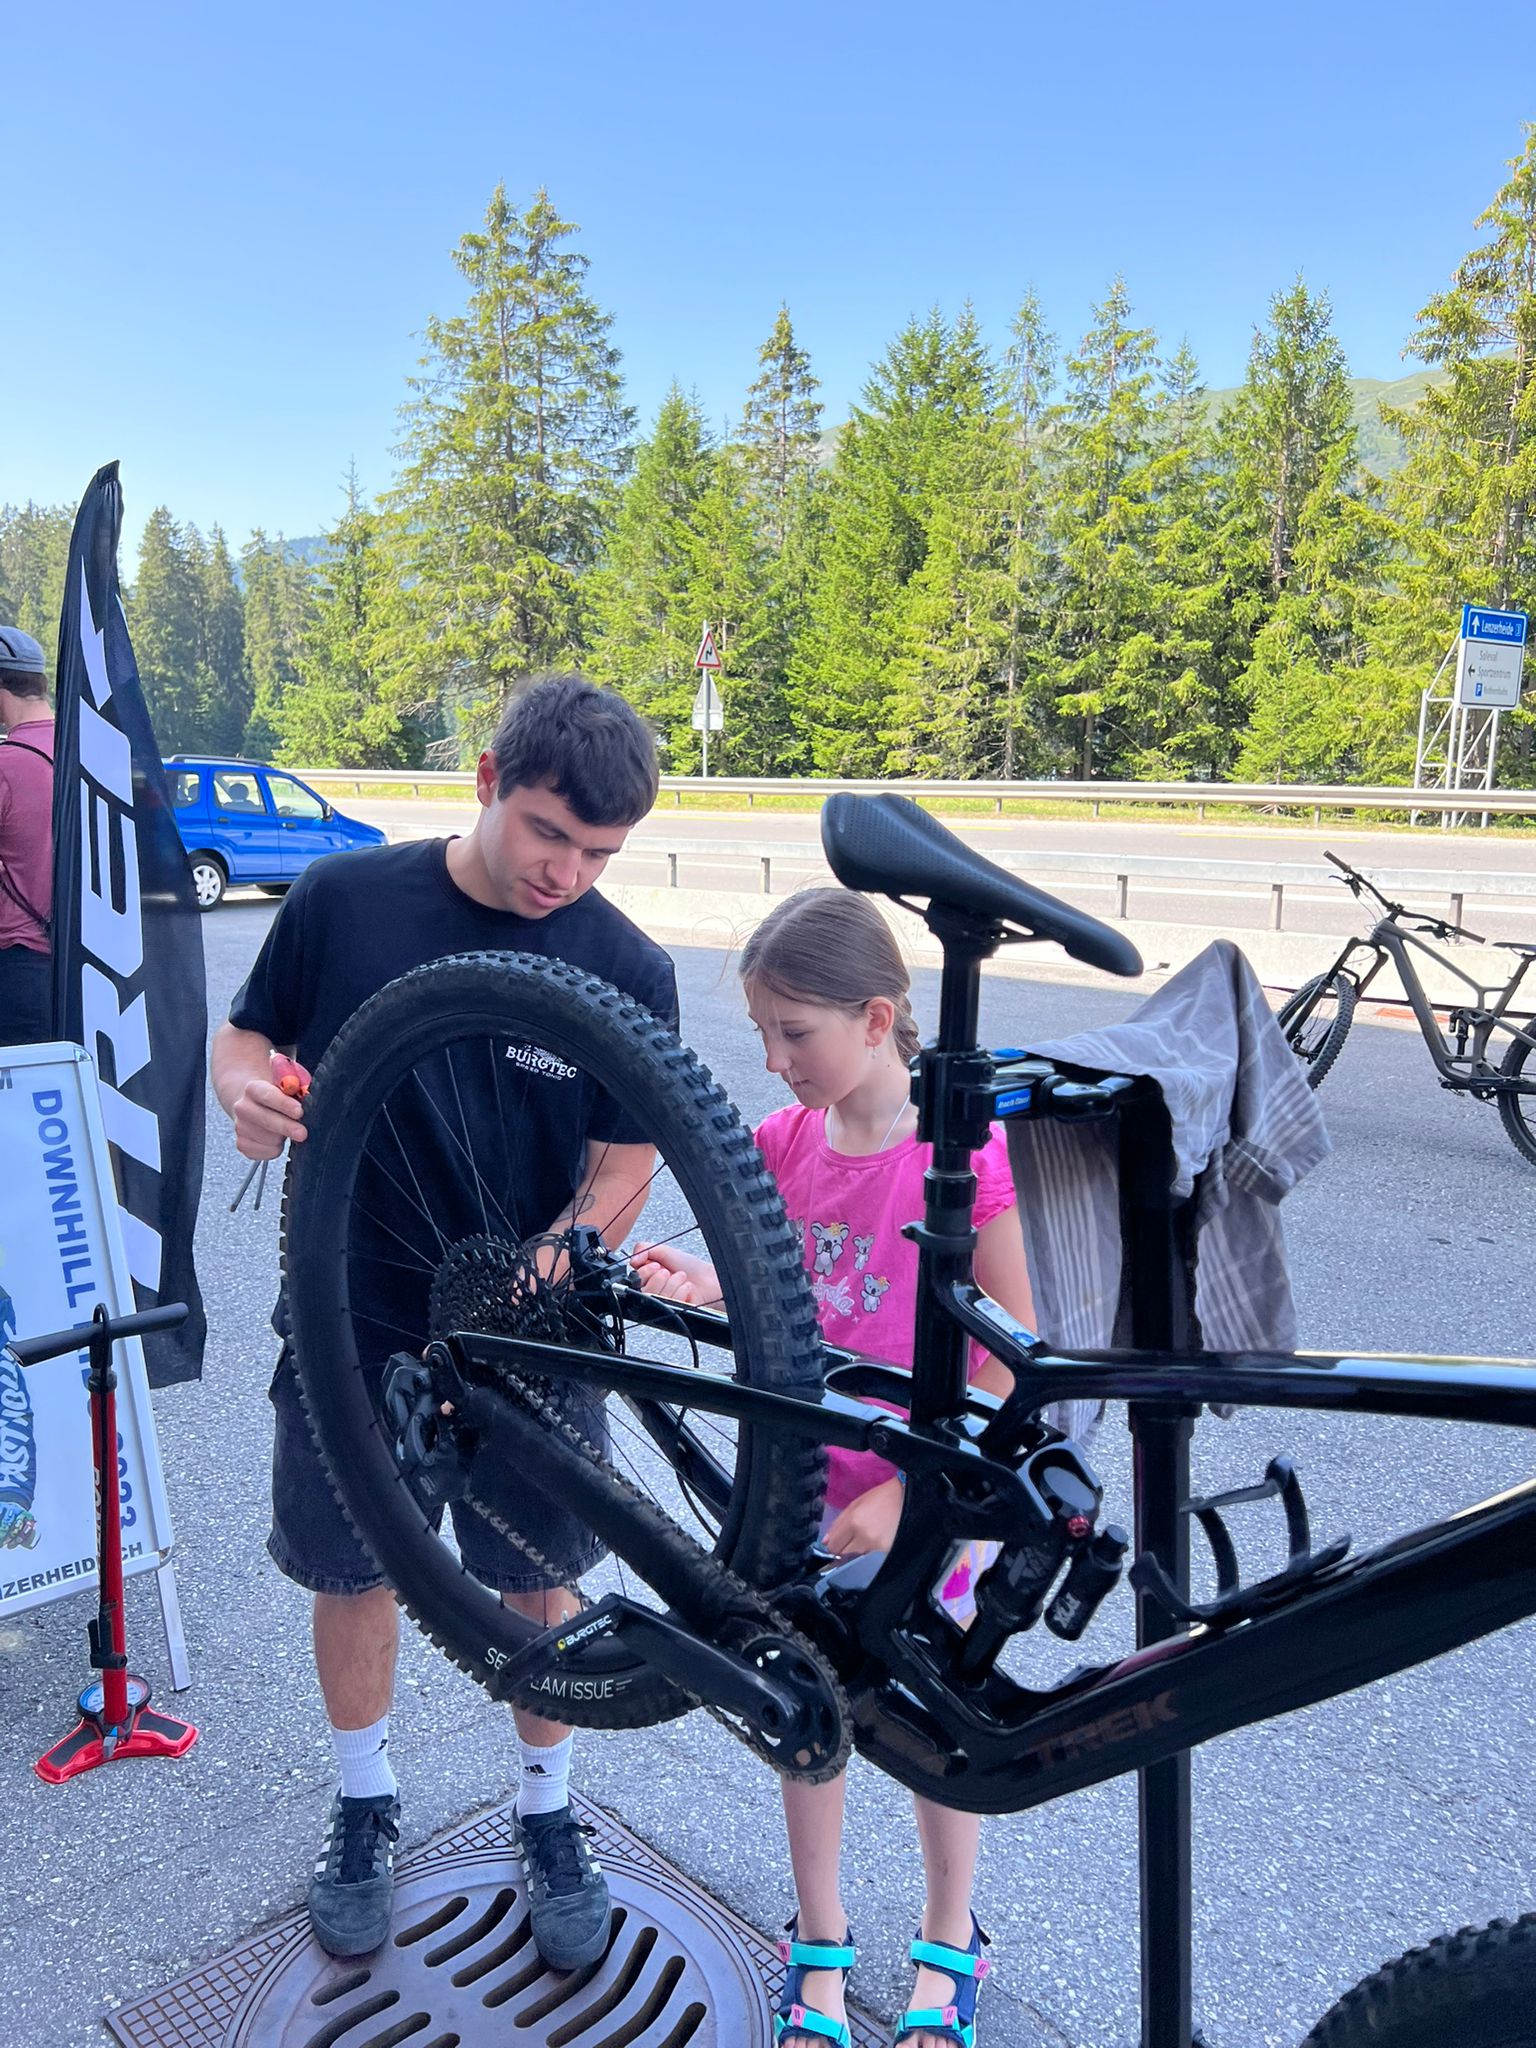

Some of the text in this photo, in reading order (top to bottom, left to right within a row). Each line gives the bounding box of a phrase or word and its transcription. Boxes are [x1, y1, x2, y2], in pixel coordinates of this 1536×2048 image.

[505, 1045, 577, 1079] BURGTEC
[32, 1090, 96, 1309] DOWNHILL
[565, 1614, 612, 1646] BURGTEC
[484, 1647, 510, 1670] SE
[570, 1679, 614, 1700] ISSUE
[1012, 1689, 1180, 1770] TREK
